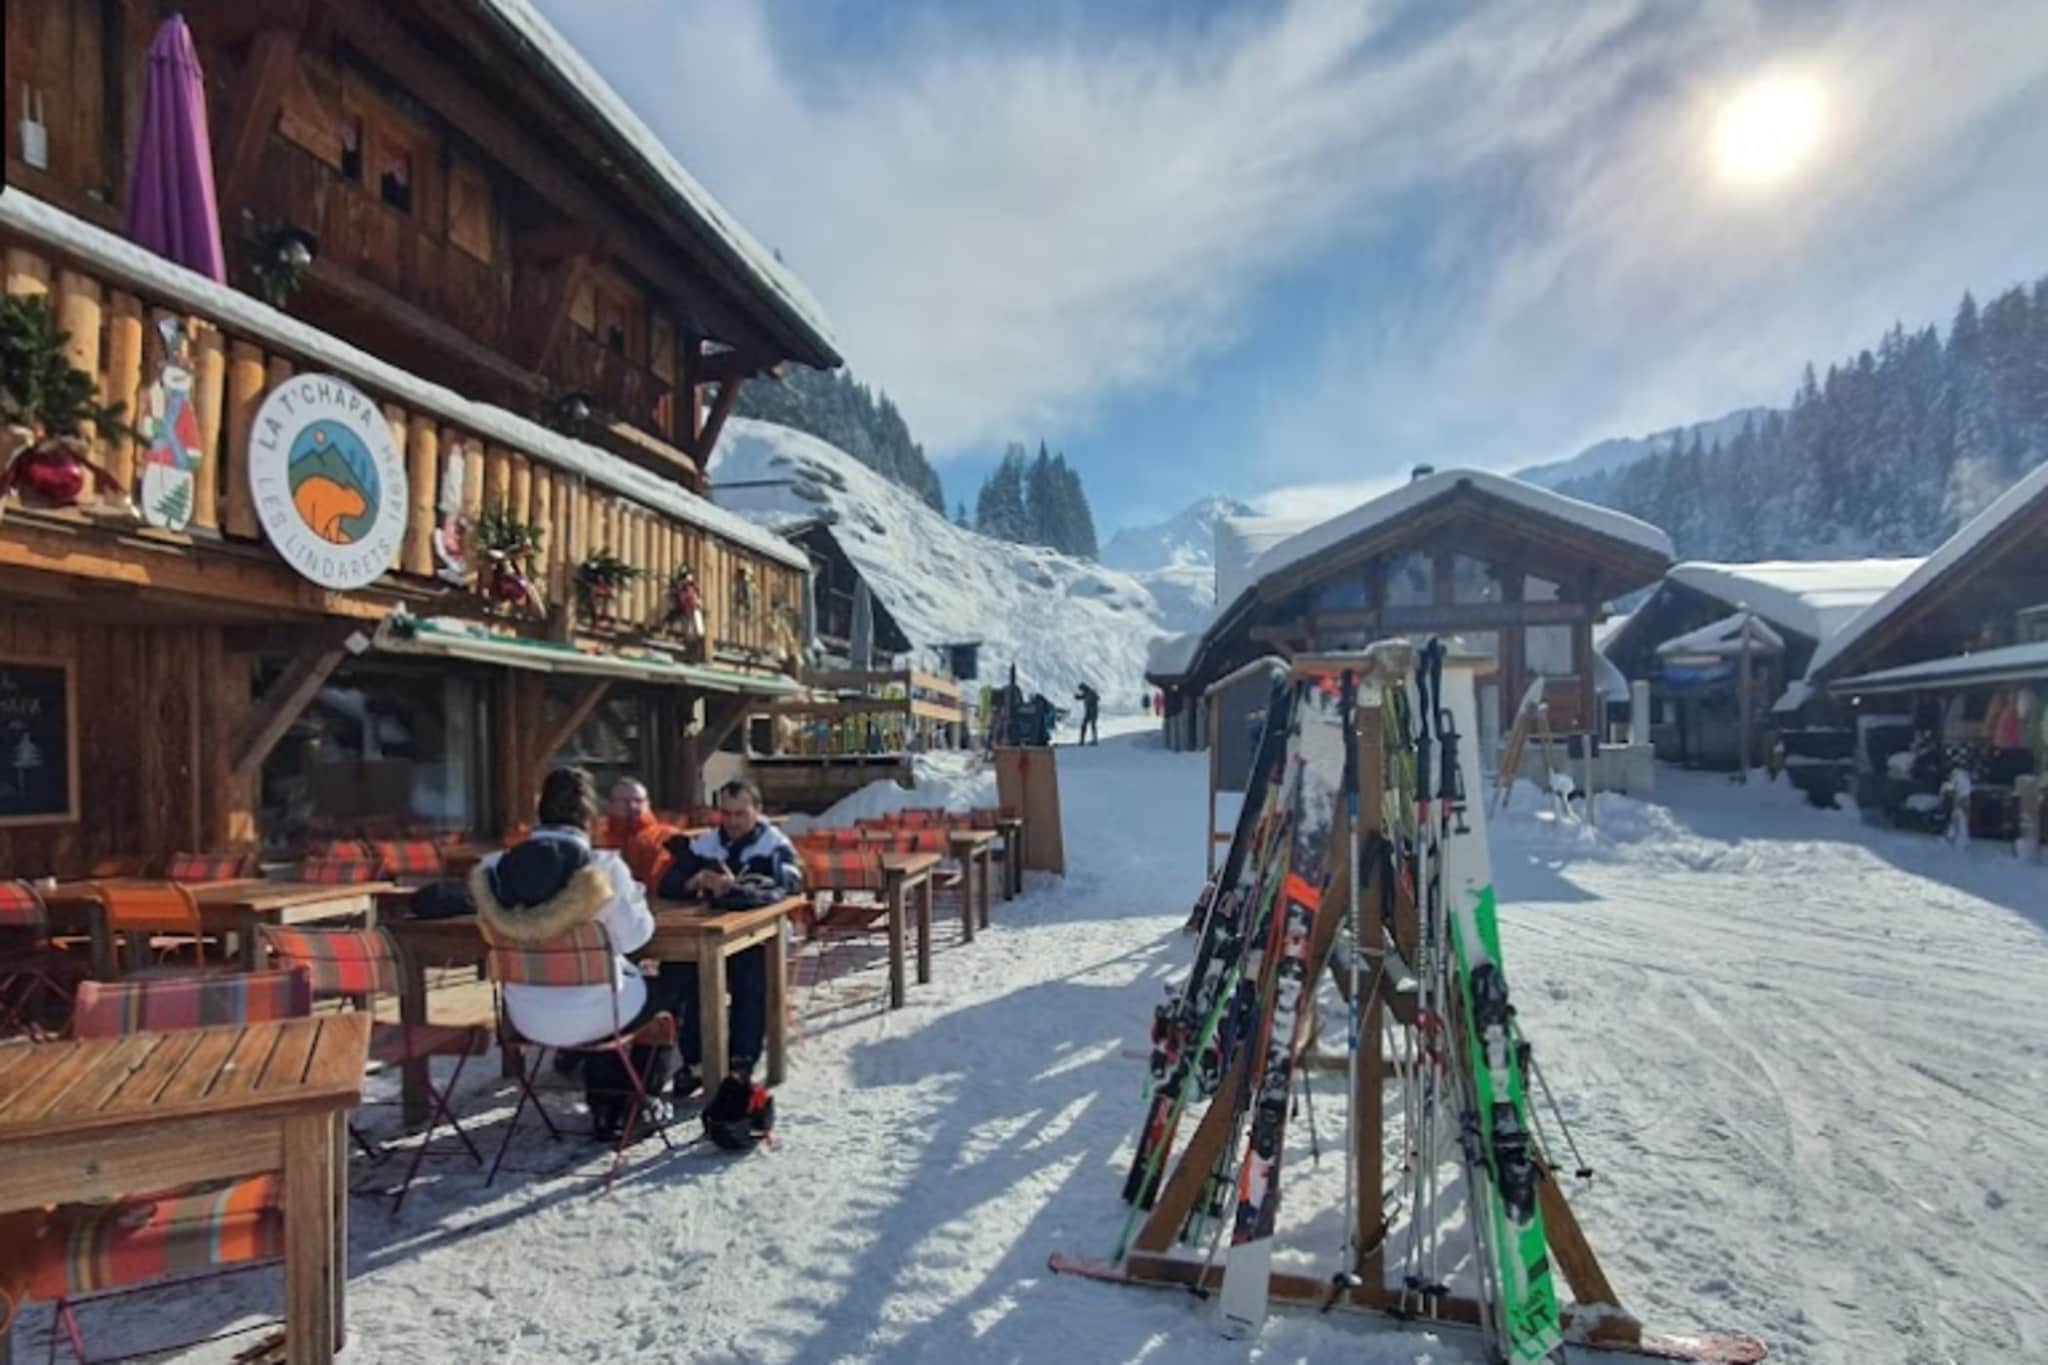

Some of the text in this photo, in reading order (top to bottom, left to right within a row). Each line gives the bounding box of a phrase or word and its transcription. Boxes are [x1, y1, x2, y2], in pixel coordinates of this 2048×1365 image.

[259, 383, 371, 451] LA T'CHAPA
[257, 477, 391, 579] LES LINDARETS
